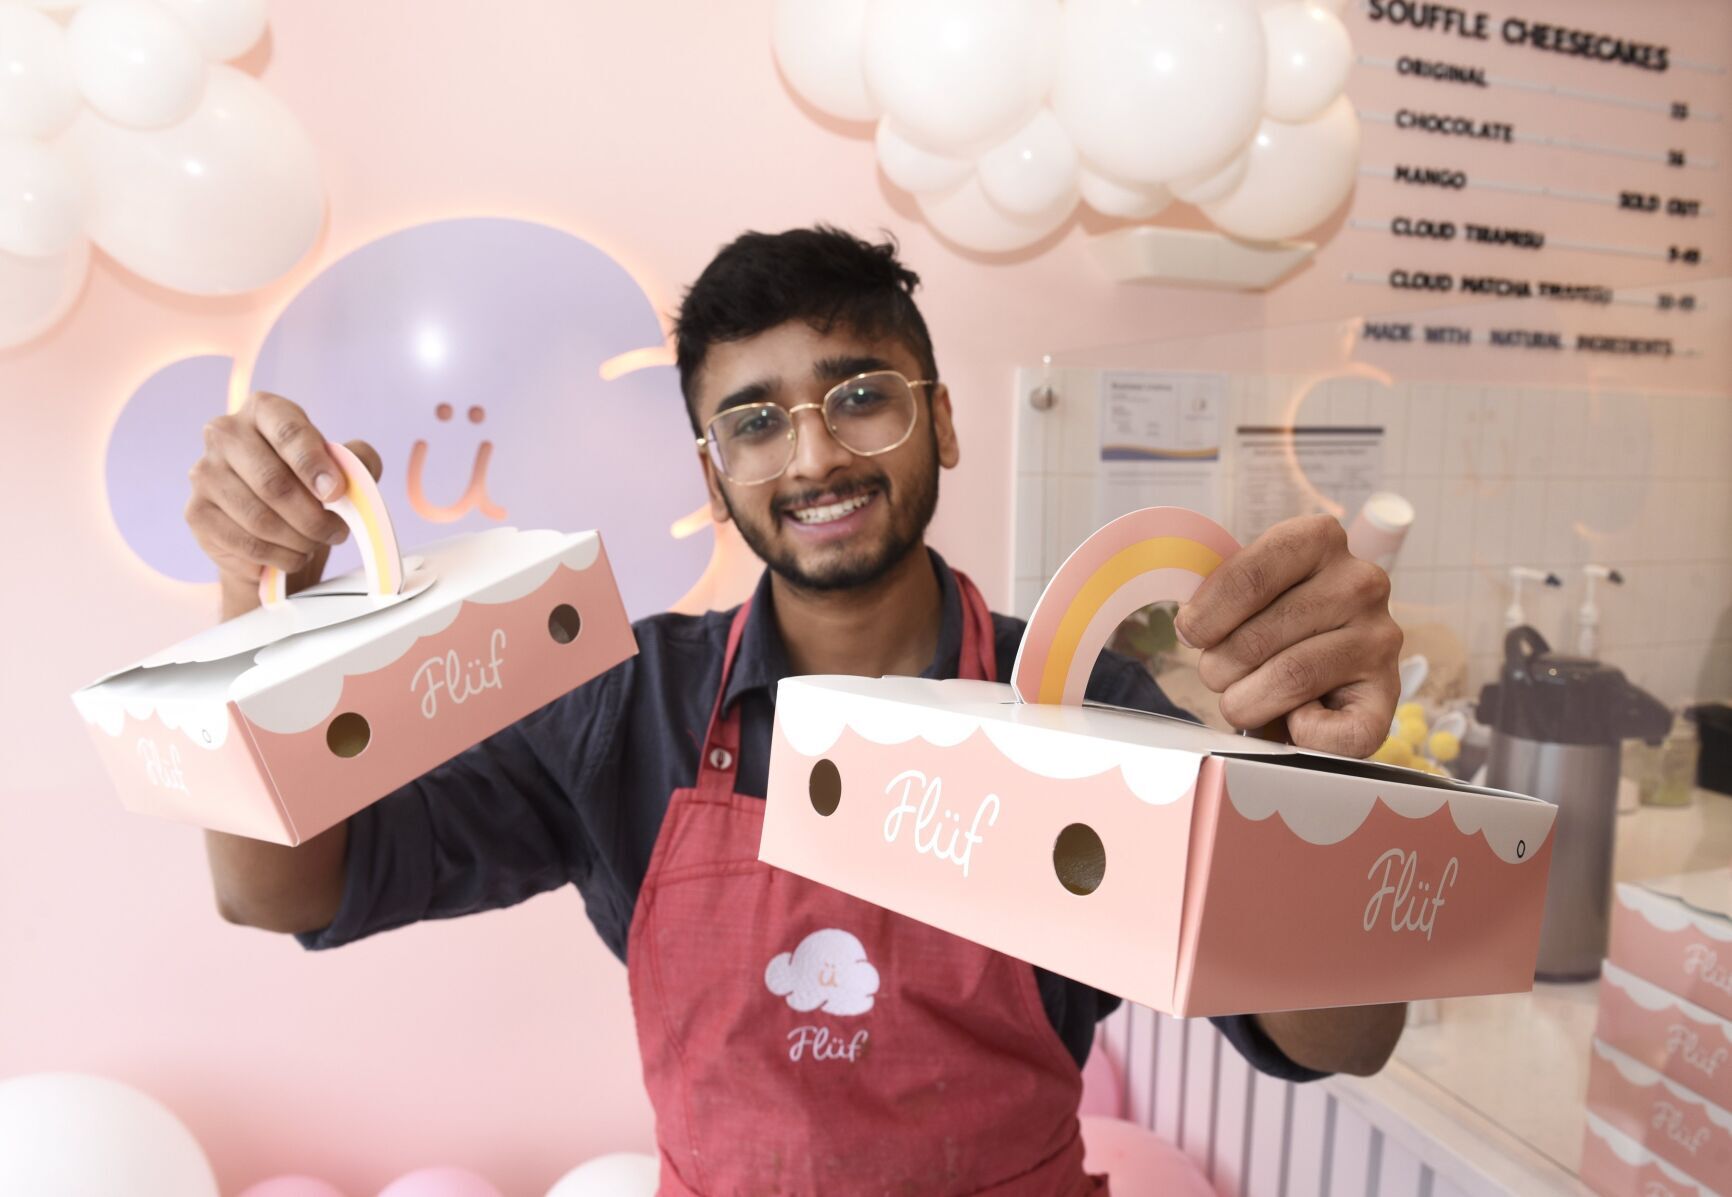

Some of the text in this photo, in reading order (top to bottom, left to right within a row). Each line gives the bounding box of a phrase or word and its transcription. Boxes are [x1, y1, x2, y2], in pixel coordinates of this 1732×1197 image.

[1369, 0, 1669, 72] SOUFFLE CHEESECAKES
[1397, 56, 1487, 87] ORIGINAL
[1395, 109, 1514, 143] CHOCOLATE
[1395, 165, 1700, 218] MANGO SOLD OUT
[1391, 218, 1456, 240] CLOUD
[1465, 223, 1545, 250] TIRAMISU
[1390, 270, 1613, 306] CLOUD MATCHA TIRAMISU
[1363, 322, 1413, 342] MADE
[1424, 326, 1471, 345] WITH
[1490, 329, 1563, 349] NATURAL
[410, 629, 507, 719] Flüf
[883, 769, 1000, 878] Flüf
[1363, 847, 1459, 942] Flüf
[786, 1025, 868, 1063] Flüf
